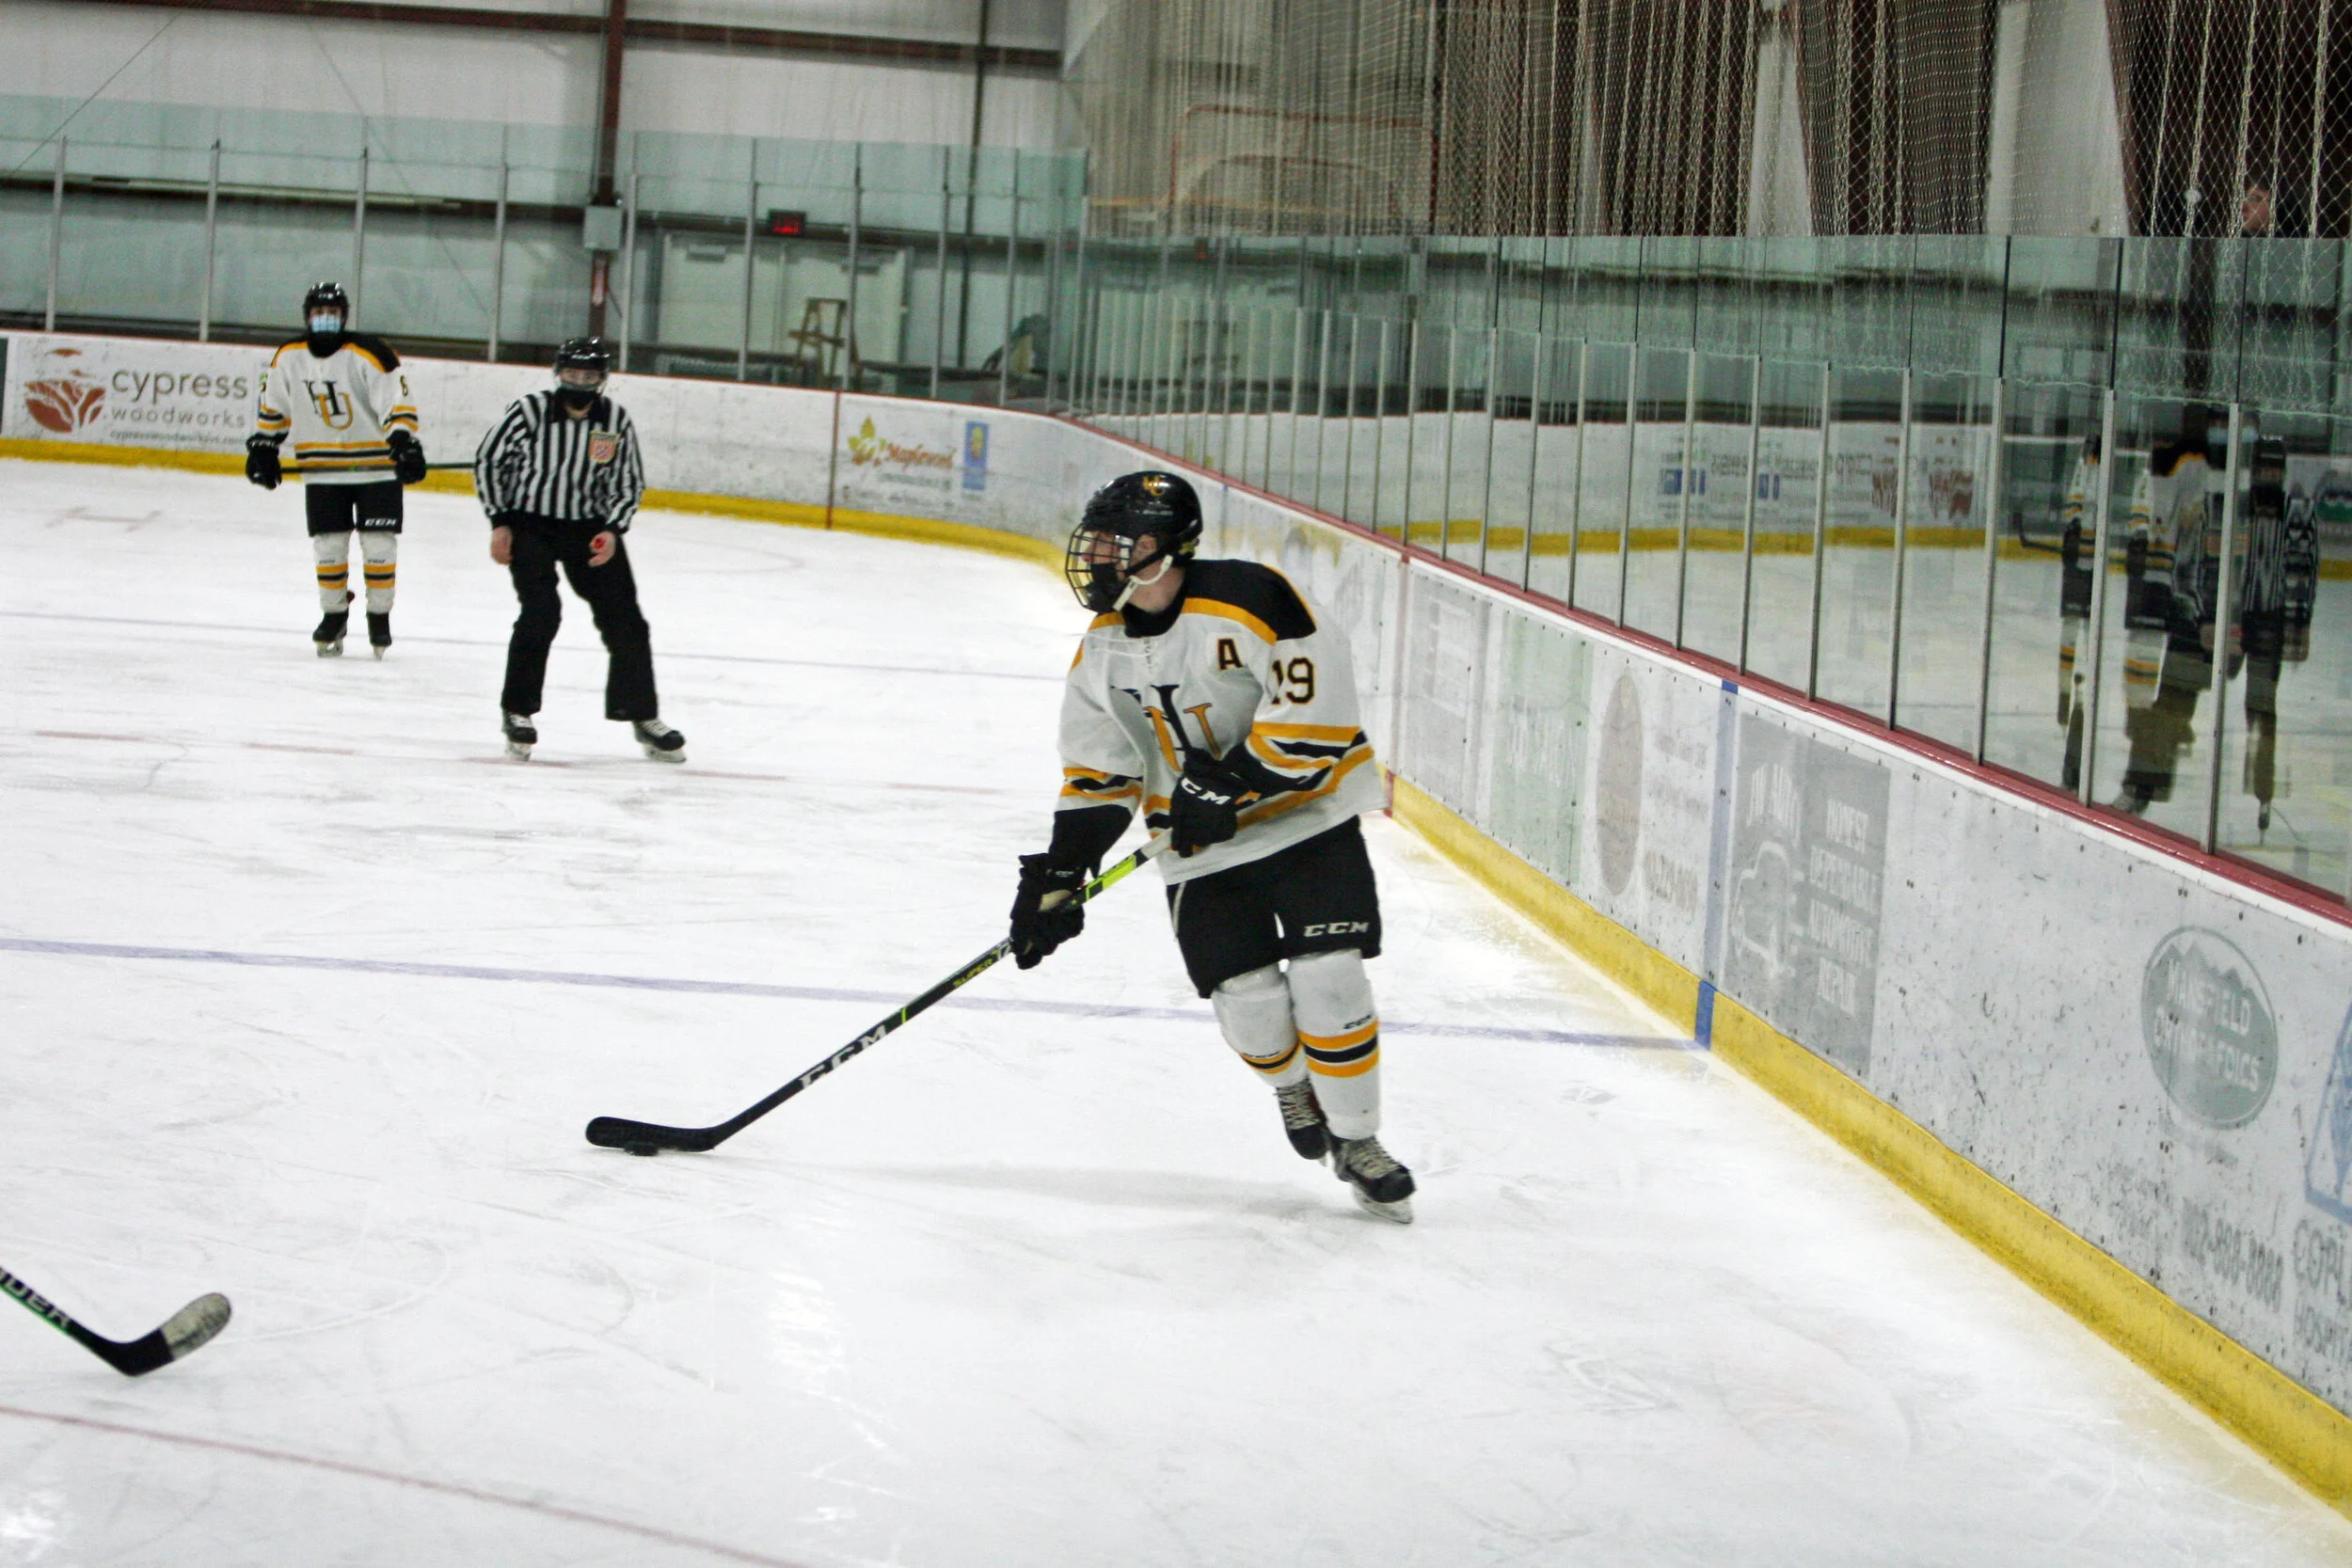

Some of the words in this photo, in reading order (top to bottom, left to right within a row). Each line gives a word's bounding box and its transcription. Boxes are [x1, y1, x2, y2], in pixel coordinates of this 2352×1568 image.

[112, 369, 248, 404] cypress
[112, 406, 246, 428] woodworks
[1217, 639, 1244, 671] A
[1271, 657, 1315, 705] 19
[1304, 922, 1369, 938] CCM
[799, 1023, 887, 1089] CCM
[2293, 1219, 2352, 1309] COPL
